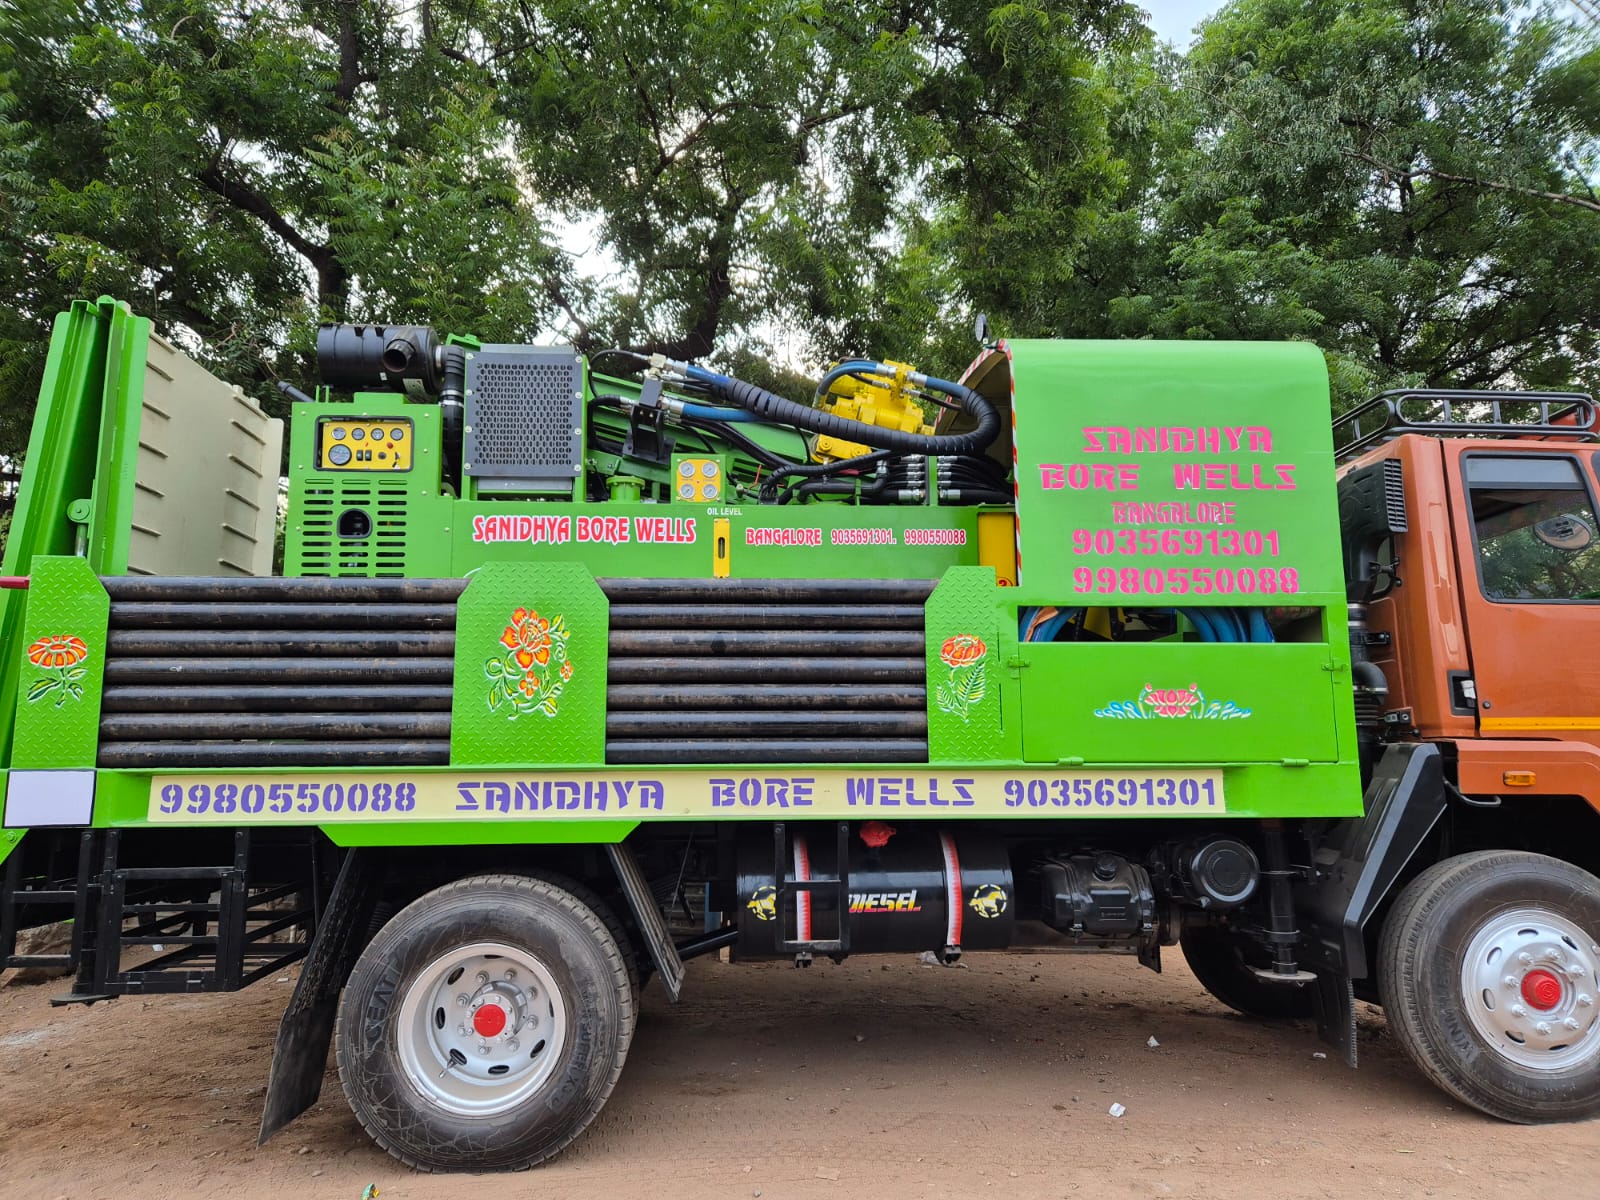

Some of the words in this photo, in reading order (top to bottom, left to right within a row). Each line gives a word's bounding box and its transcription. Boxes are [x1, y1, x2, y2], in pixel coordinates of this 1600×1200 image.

[1083, 426, 1273, 454] SANIDHYA
[1040, 464, 1140, 491] BORE
[1174, 464, 1297, 490] WELLS
[706, 507, 719, 516] OIL
[720, 507, 743, 516] LEVEL
[1112, 501, 1236, 525] BANGALORE
[473, 515, 571, 545] SANIDHYA
[577, 516, 631, 545] BORE
[635, 517, 697, 544] WELLS
[745, 527, 822, 546] BANGALORE
[904, 528, 967, 546] 9980550088
[1072, 529, 1280, 556] 9035691301
[1073, 567, 1300, 594] 9980550088
[160, 783, 417, 814] 9980550088
[456, 780, 665, 813] SANIDHYA
[709, 778, 815, 807] BORE
[846, 778, 975, 806] WELLS
[1004, 779, 1215, 807] 9035691301
